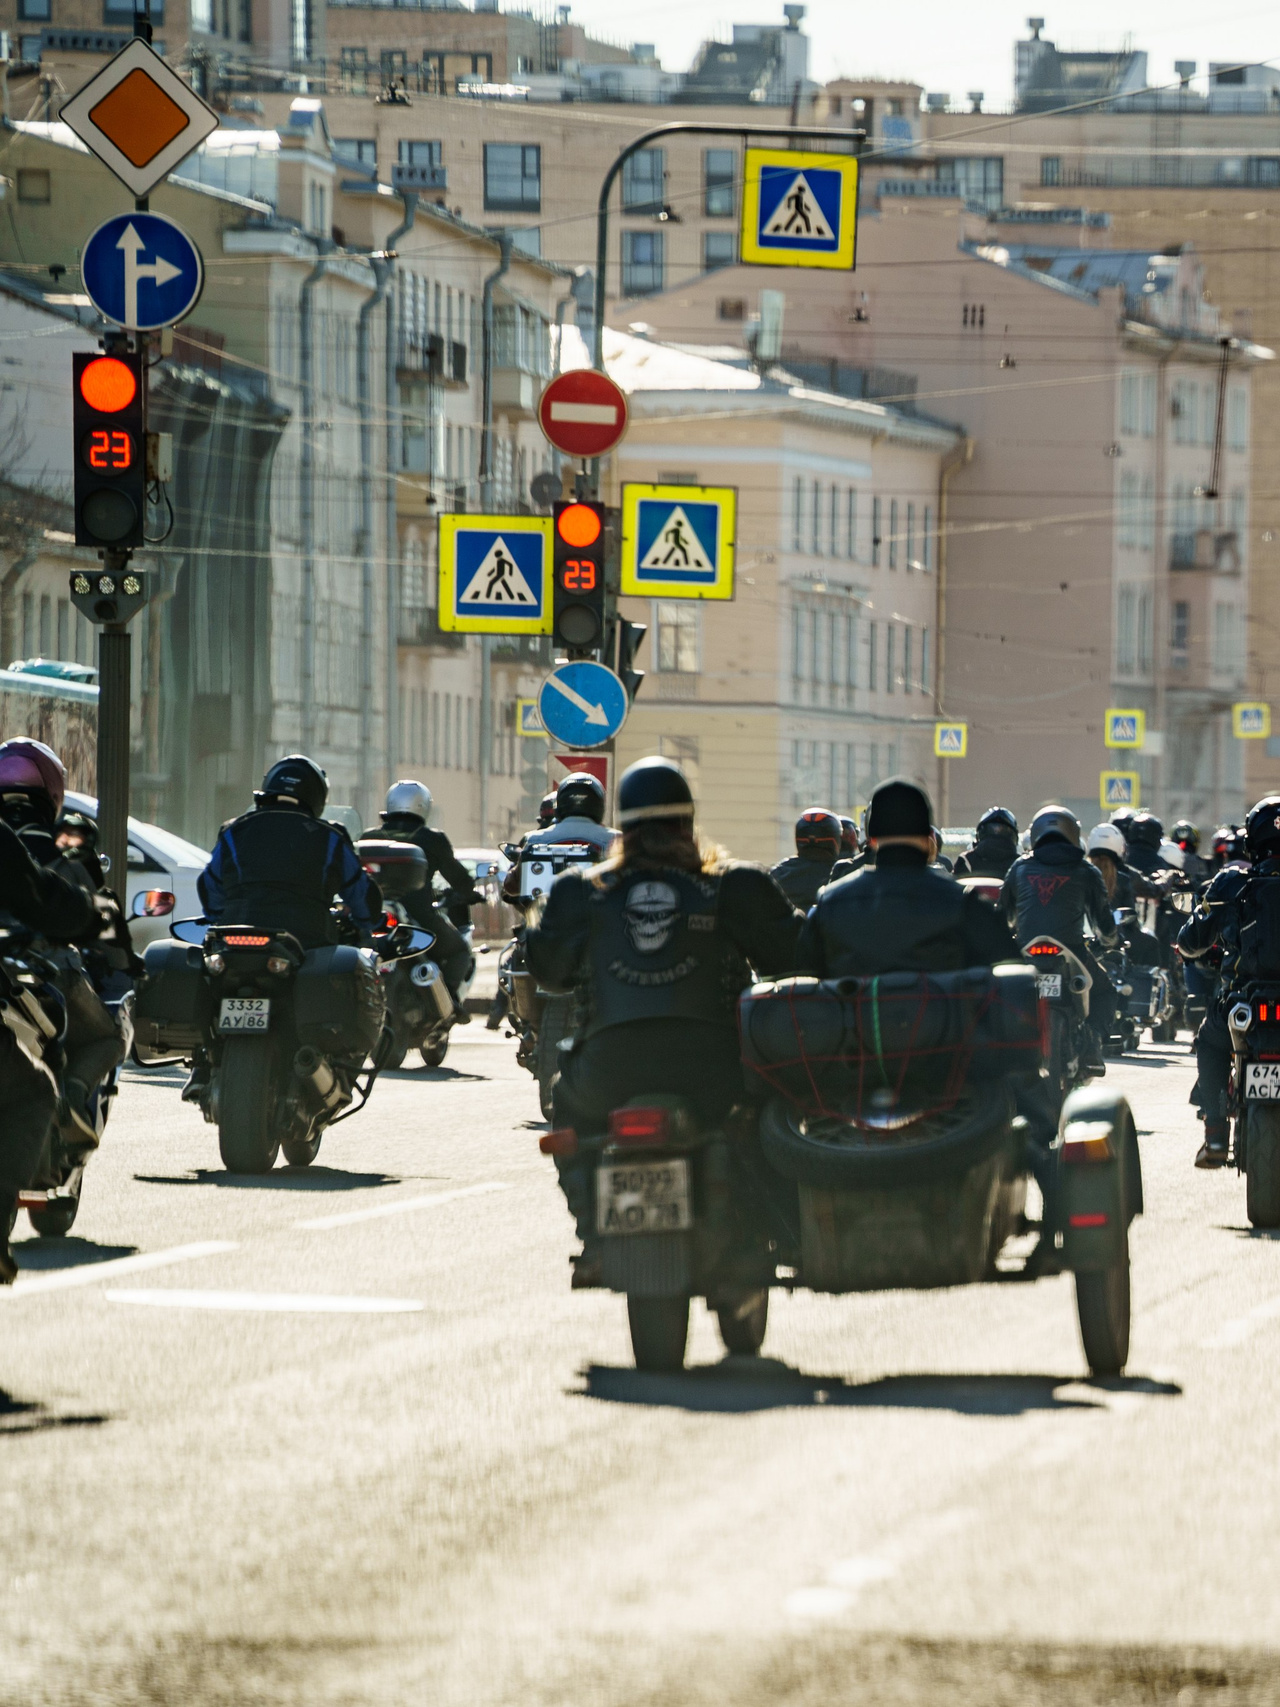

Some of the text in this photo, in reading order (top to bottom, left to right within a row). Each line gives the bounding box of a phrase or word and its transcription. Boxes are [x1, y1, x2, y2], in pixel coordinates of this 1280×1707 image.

[90, 431, 130, 468] 23
[564, 560, 596, 589] 23
[227, 1000, 264, 1011] 3332
[247, 1016, 265, 1027] 86
